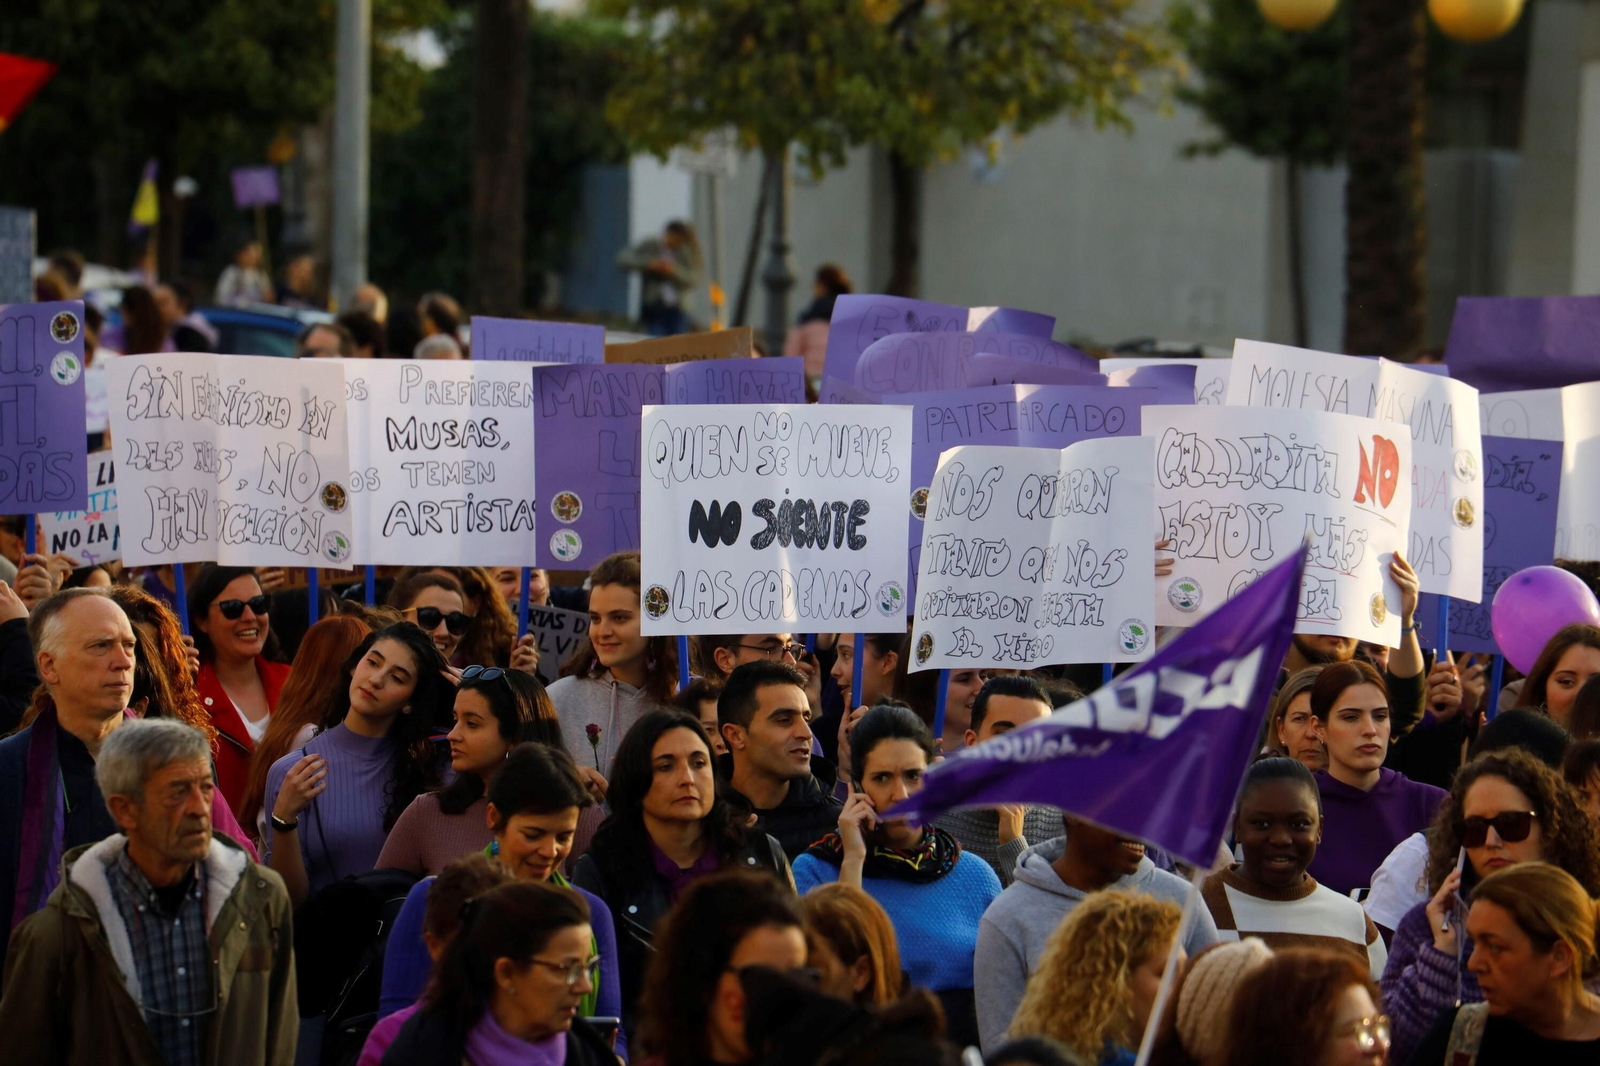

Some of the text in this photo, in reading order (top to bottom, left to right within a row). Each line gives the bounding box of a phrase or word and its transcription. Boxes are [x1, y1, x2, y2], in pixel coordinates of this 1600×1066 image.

[126, 365, 184, 421] SIN
[298, 396, 337, 441] EN
[925, 400, 1126, 443] PATRIARCADO
[386, 416, 510, 451] MUSAS,
[647, 411, 900, 489] QUIEN NO SE MUEVE,
[256, 441, 321, 504] NO
[400, 460, 496, 489] TEMEN
[934, 461, 1005, 522] NOS
[1156, 427, 1342, 499] CALLADITA
[1353, 433, 1400, 510] NO
[52, 529, 82, 555] NO
[87, 522, 109, 545] LA
[383, 492, 536, 537] ARTISTA
[688, 499, 743, 549] NO
[749, 487, 871, 551] SIENTE
[1158, 499, 1284, 564] ESTOY
[1062, 538, 1129, 589] NOS
[671, 569, 738, 624] LAS
[741, 568, 872, 622] CADENAS
[944, 626, 984, 659] EL
